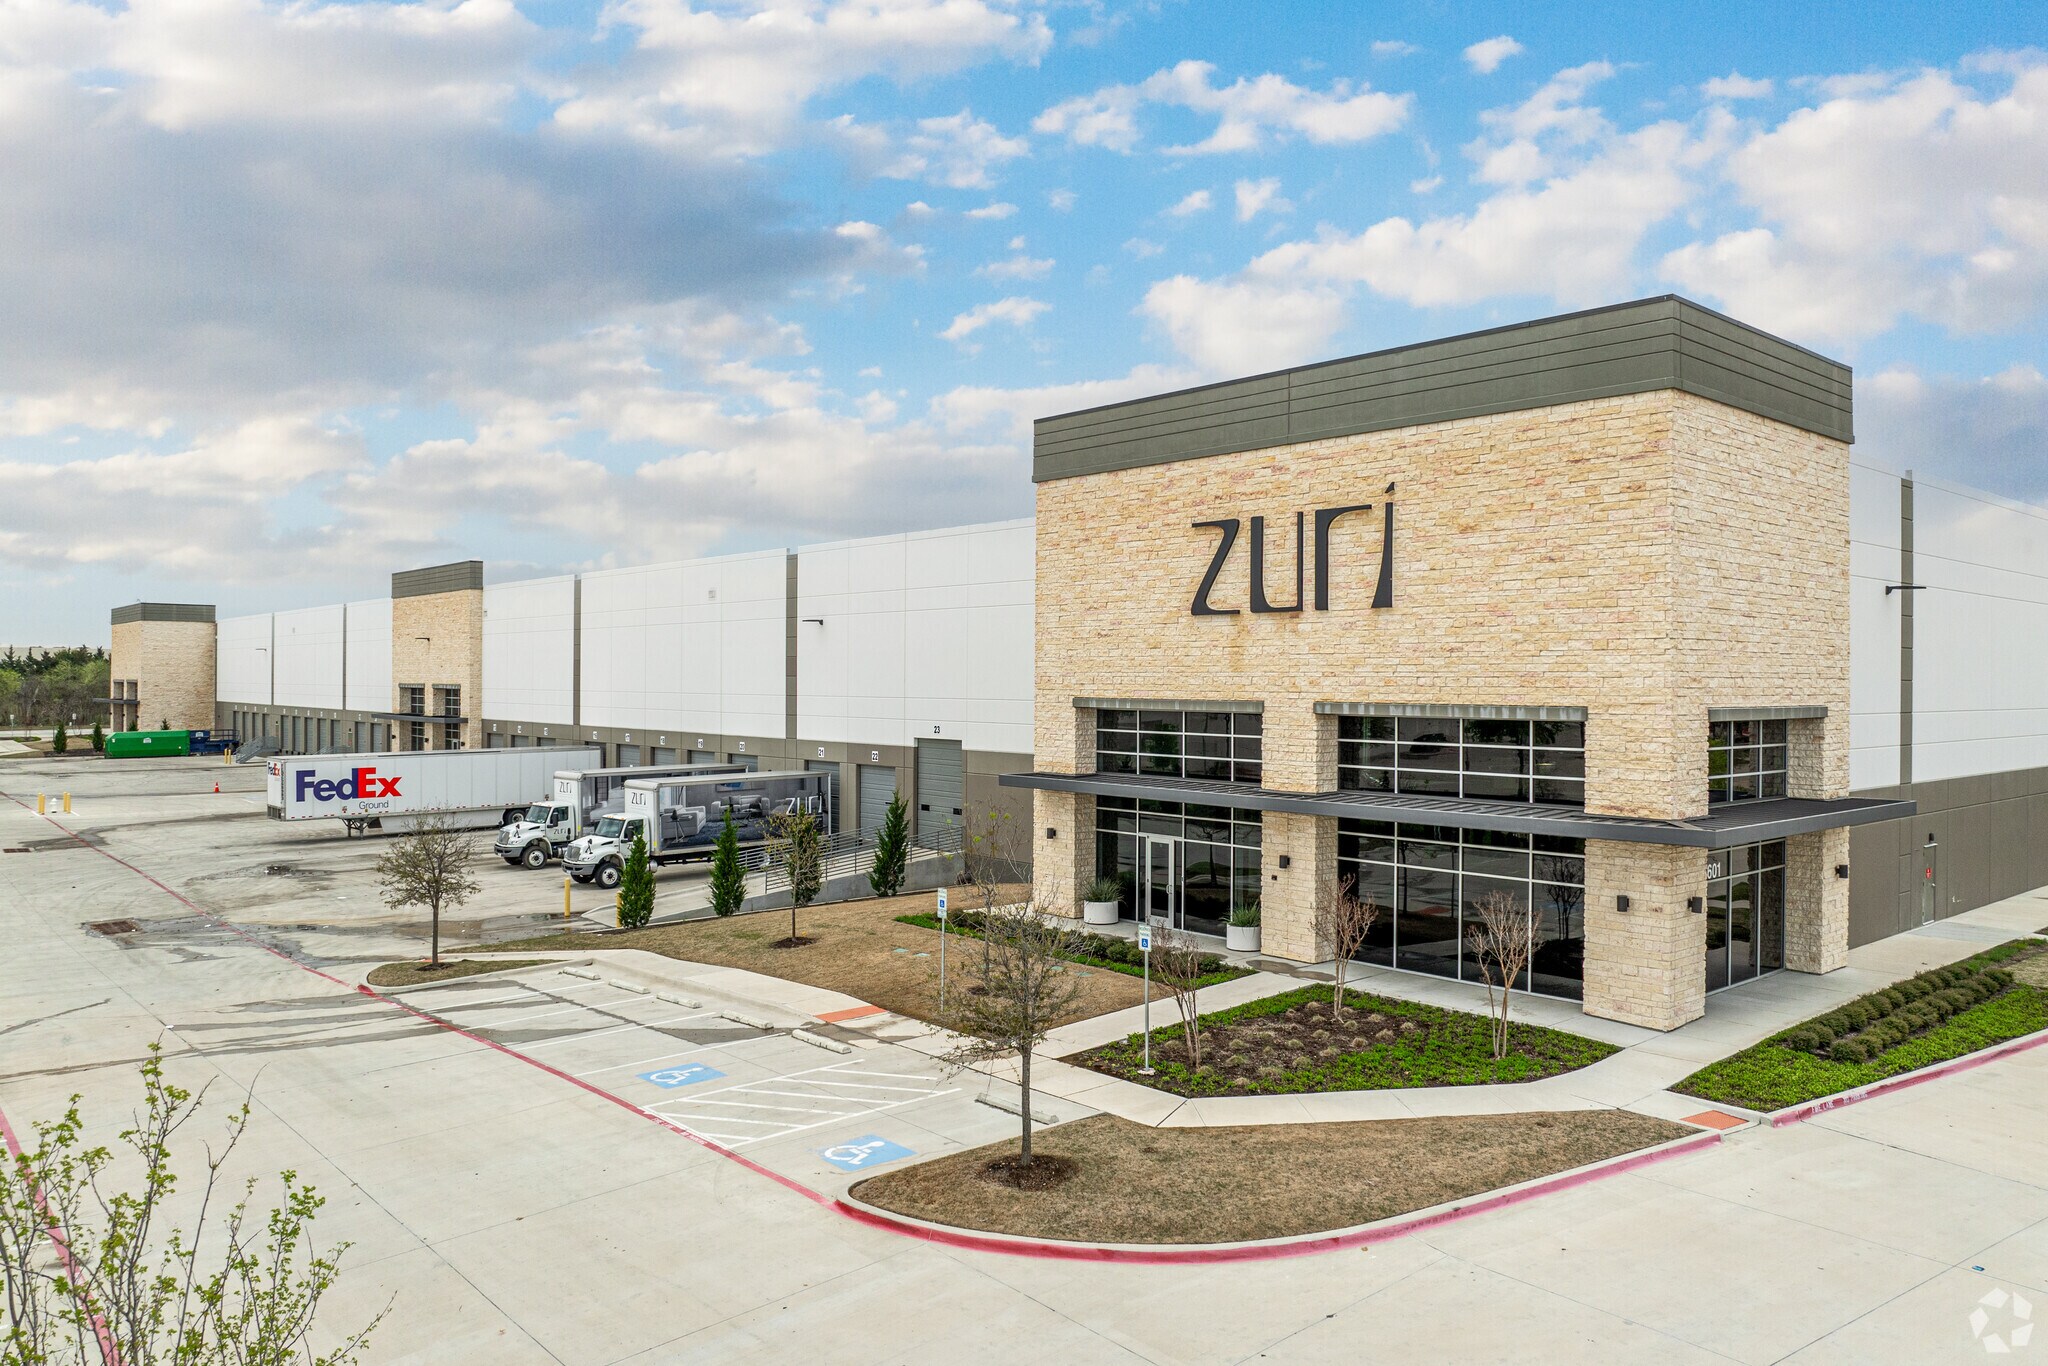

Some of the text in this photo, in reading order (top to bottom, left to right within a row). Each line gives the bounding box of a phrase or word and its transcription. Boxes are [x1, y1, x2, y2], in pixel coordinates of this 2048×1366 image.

[933, 725, 941, 734] 23
[818, 748, 824, 756] 21
[872, 753, 878, 761] 22
[296, 767, 402, 802] FedEx
[359, 801, 389, 810] Ground
